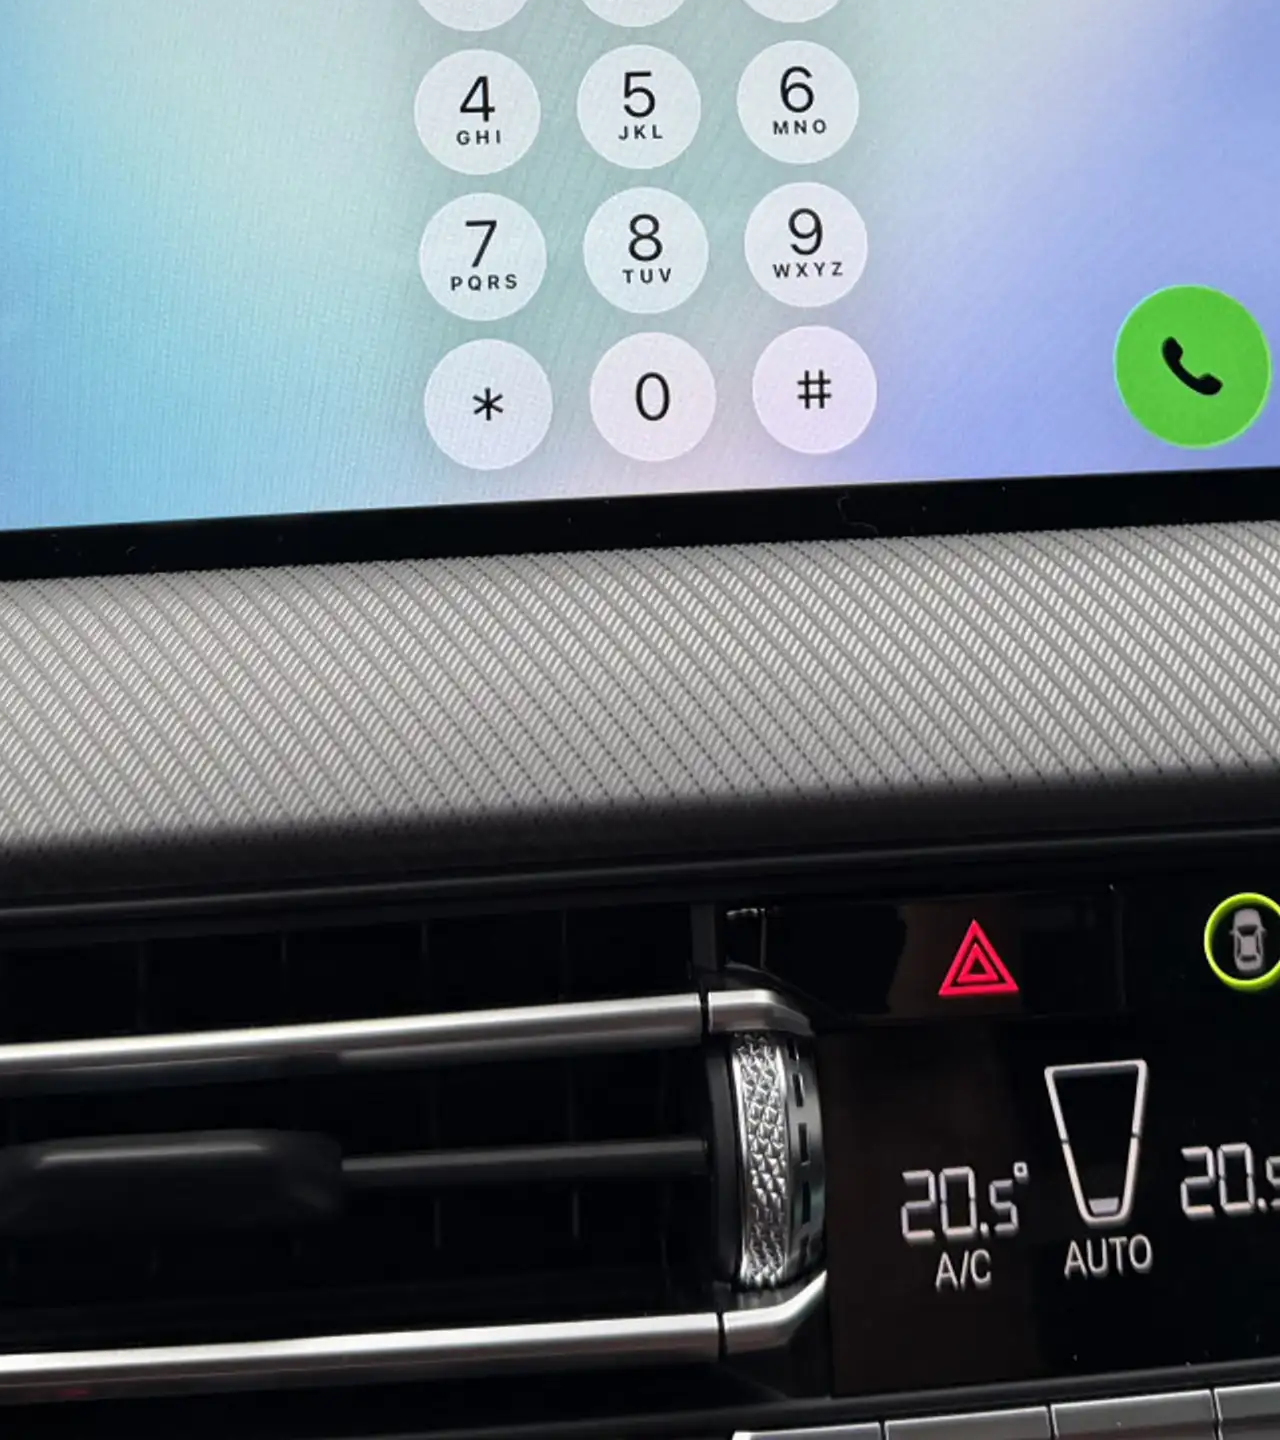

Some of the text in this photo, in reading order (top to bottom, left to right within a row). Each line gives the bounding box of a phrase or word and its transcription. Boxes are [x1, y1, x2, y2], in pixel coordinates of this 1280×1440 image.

[458, 74, 497, 124] 4
[622, 69, 657, 120] 5
[778, 64, 816, 115] 6
[454, 128, 502, 147] GHI
[617, 122, 664, 142] JKL
[771, 117, 828, 137] MNO
[464, 218, 499, 269] 7
[627, 212, 664, 264] 8
[786, 206, 824, 257] 9
[449, 272, 519, 293] PQRS
[620, 266, 673, 286] TUV
[770, 260, 844, 280] WXYZ
[634, 370, 672, 423] 0
[934, 1247, 992, 1290] A/C
[1062, 1232, 1154, 1278] AUTO
